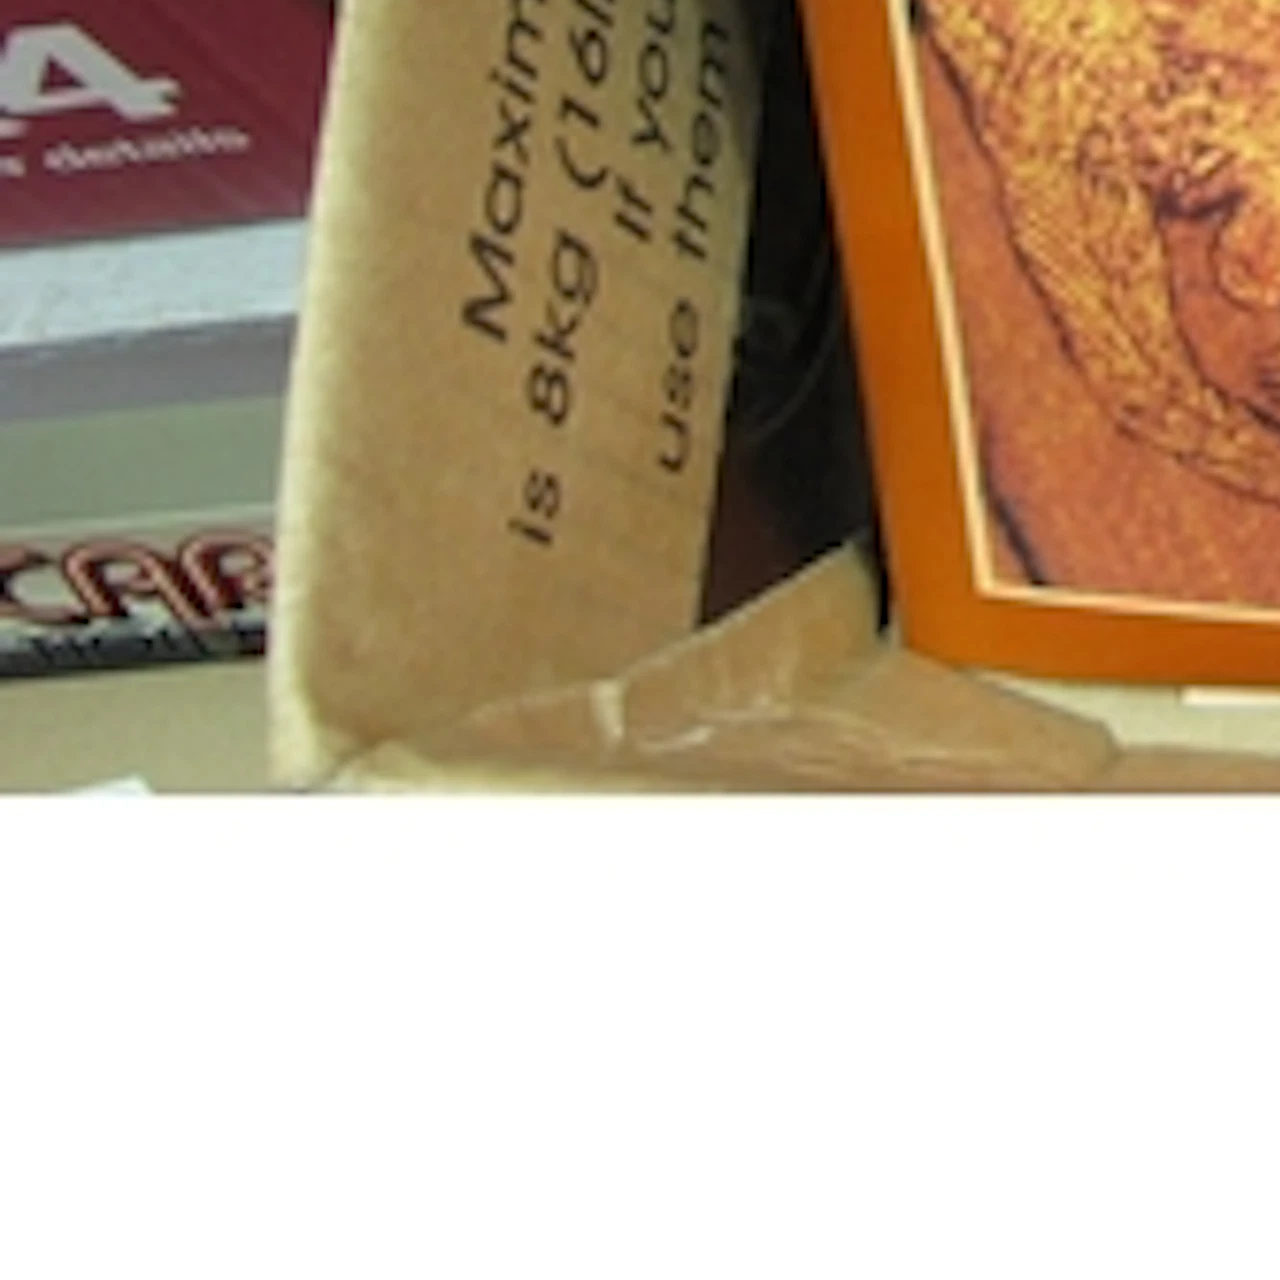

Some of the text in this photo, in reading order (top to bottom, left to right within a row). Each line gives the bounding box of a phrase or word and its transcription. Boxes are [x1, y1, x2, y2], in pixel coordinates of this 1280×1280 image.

[670, 18, 732, 264] them
[521, 225, 600, 430] 8kg
[651, 295, 703, 477] use
[505, 465, 565, 550] is
